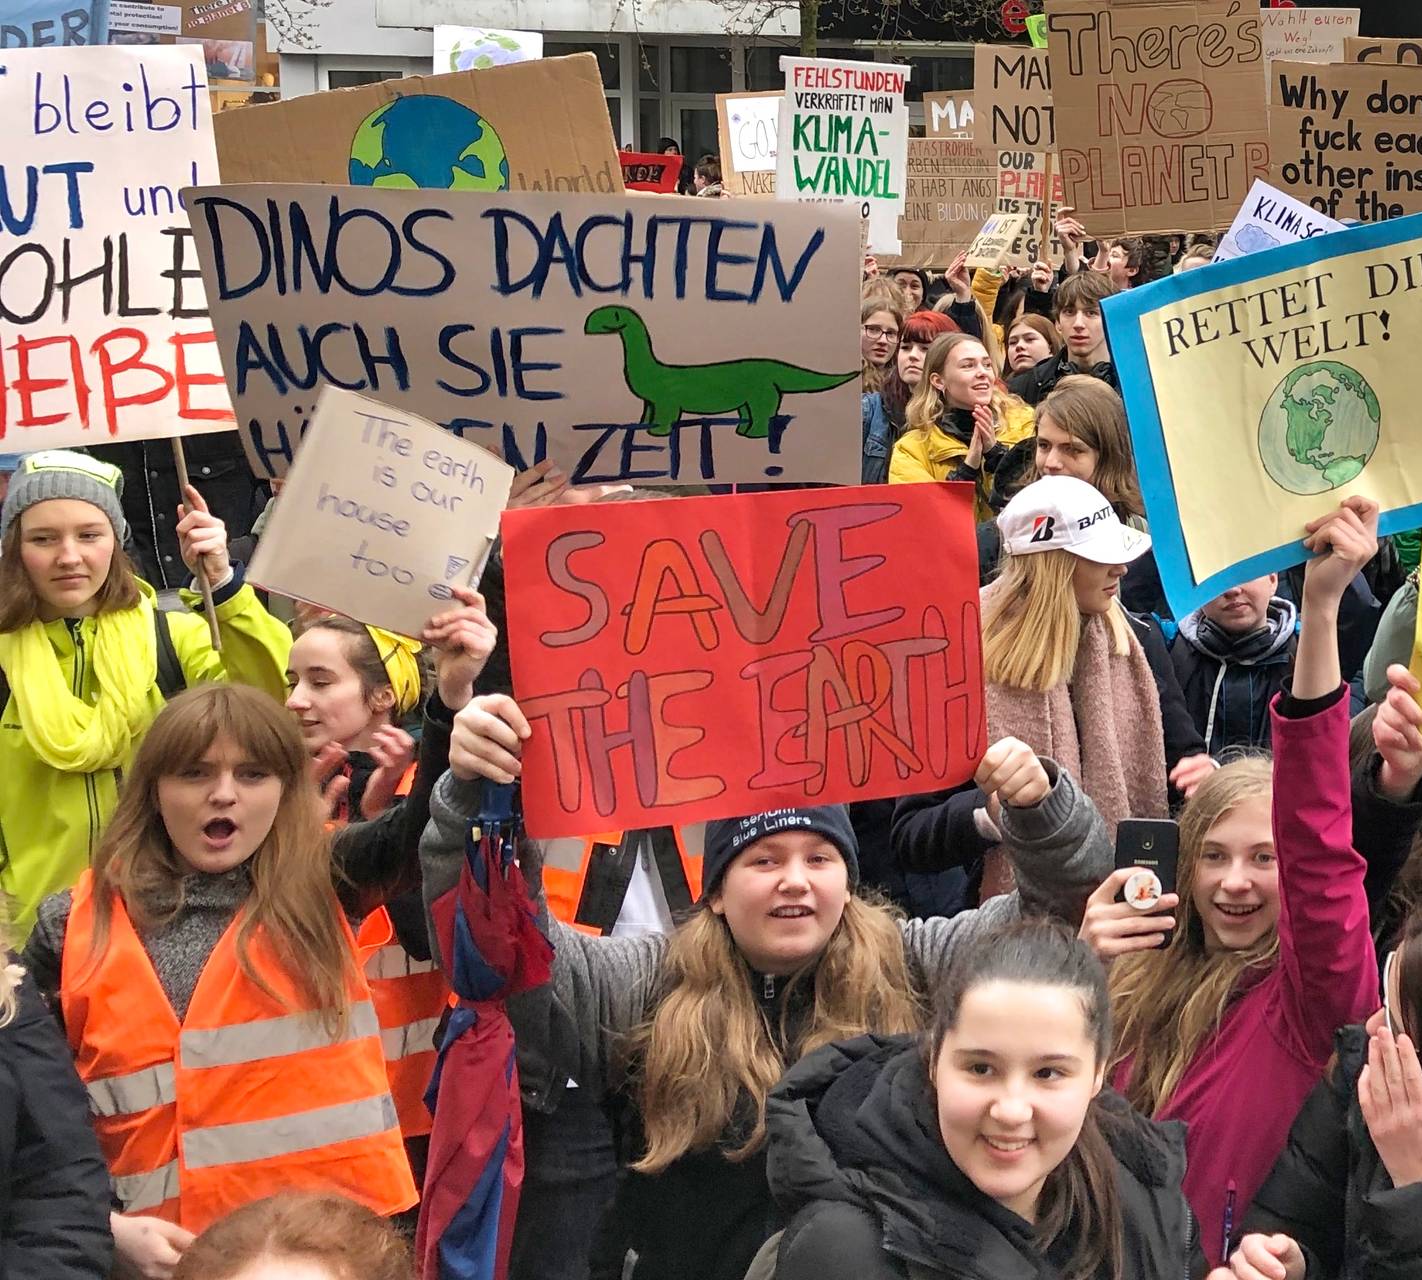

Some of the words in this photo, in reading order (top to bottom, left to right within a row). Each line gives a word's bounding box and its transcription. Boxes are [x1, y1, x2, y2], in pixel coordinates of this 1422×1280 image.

[1048, 1, 1262, 76] There's
[1314, 14, 1353, 25] euren
[794, 67, 905, 94] FEHLSTUNDEN
[994, 54, 1052, 92] MA
[34, 63, 207, 135] bleibt
[795, 92, 866, 112] VERKRAFTET
[870, 96, 893, 114] MAN
[1280, 75, 1349, 119] Why
[793, 114, 890, 156] KLIMA-
[907, 142, 982, 157] ATASTROPHEN
[1300, 119, 1362, 152] fuck
[793, 155, 899, 199] WANDEL
[908, 159, 939, 174] RBEN
[999, 152, 1035, 170] OUR
[1060, 144, 1235, 211] PLANET
[1281, 152, 1374, 188] other
[0, 162, 95, 236] UT
[921, 179, 954, 197] HABT
[999, 199, 1020, 213] ITS
[903, 202, 933, 221] EINE
[195, 196, 455, 299] DINOS
[482, 211, 825, 303] DACHTEN
[0, 227, 209, 324] OHLE
[1163, 272, 1334, 357] RETTET
[236, 321, 409, 396] AUCH
[438, 324, 565, 400] SIE
[1242, 309, 1391, 369] WELT!
[354, 411, 412, 457] The
[422, 449, 485, 494] earth
[373, 457, 398, 488] is
[411, 481, 463, 512] our
[316, 482, 410, 537] house
[1077, 506, 1114, 530] BATT
[350, 540, 415, 586] too
[540, 503, 904, 655] SAVE
[512, 668, 727, 817] THE
[740, 601, 988, 797] EARTH
[732, 827, 758, 847] Blue
[764, 815, 812, 832] Liners
